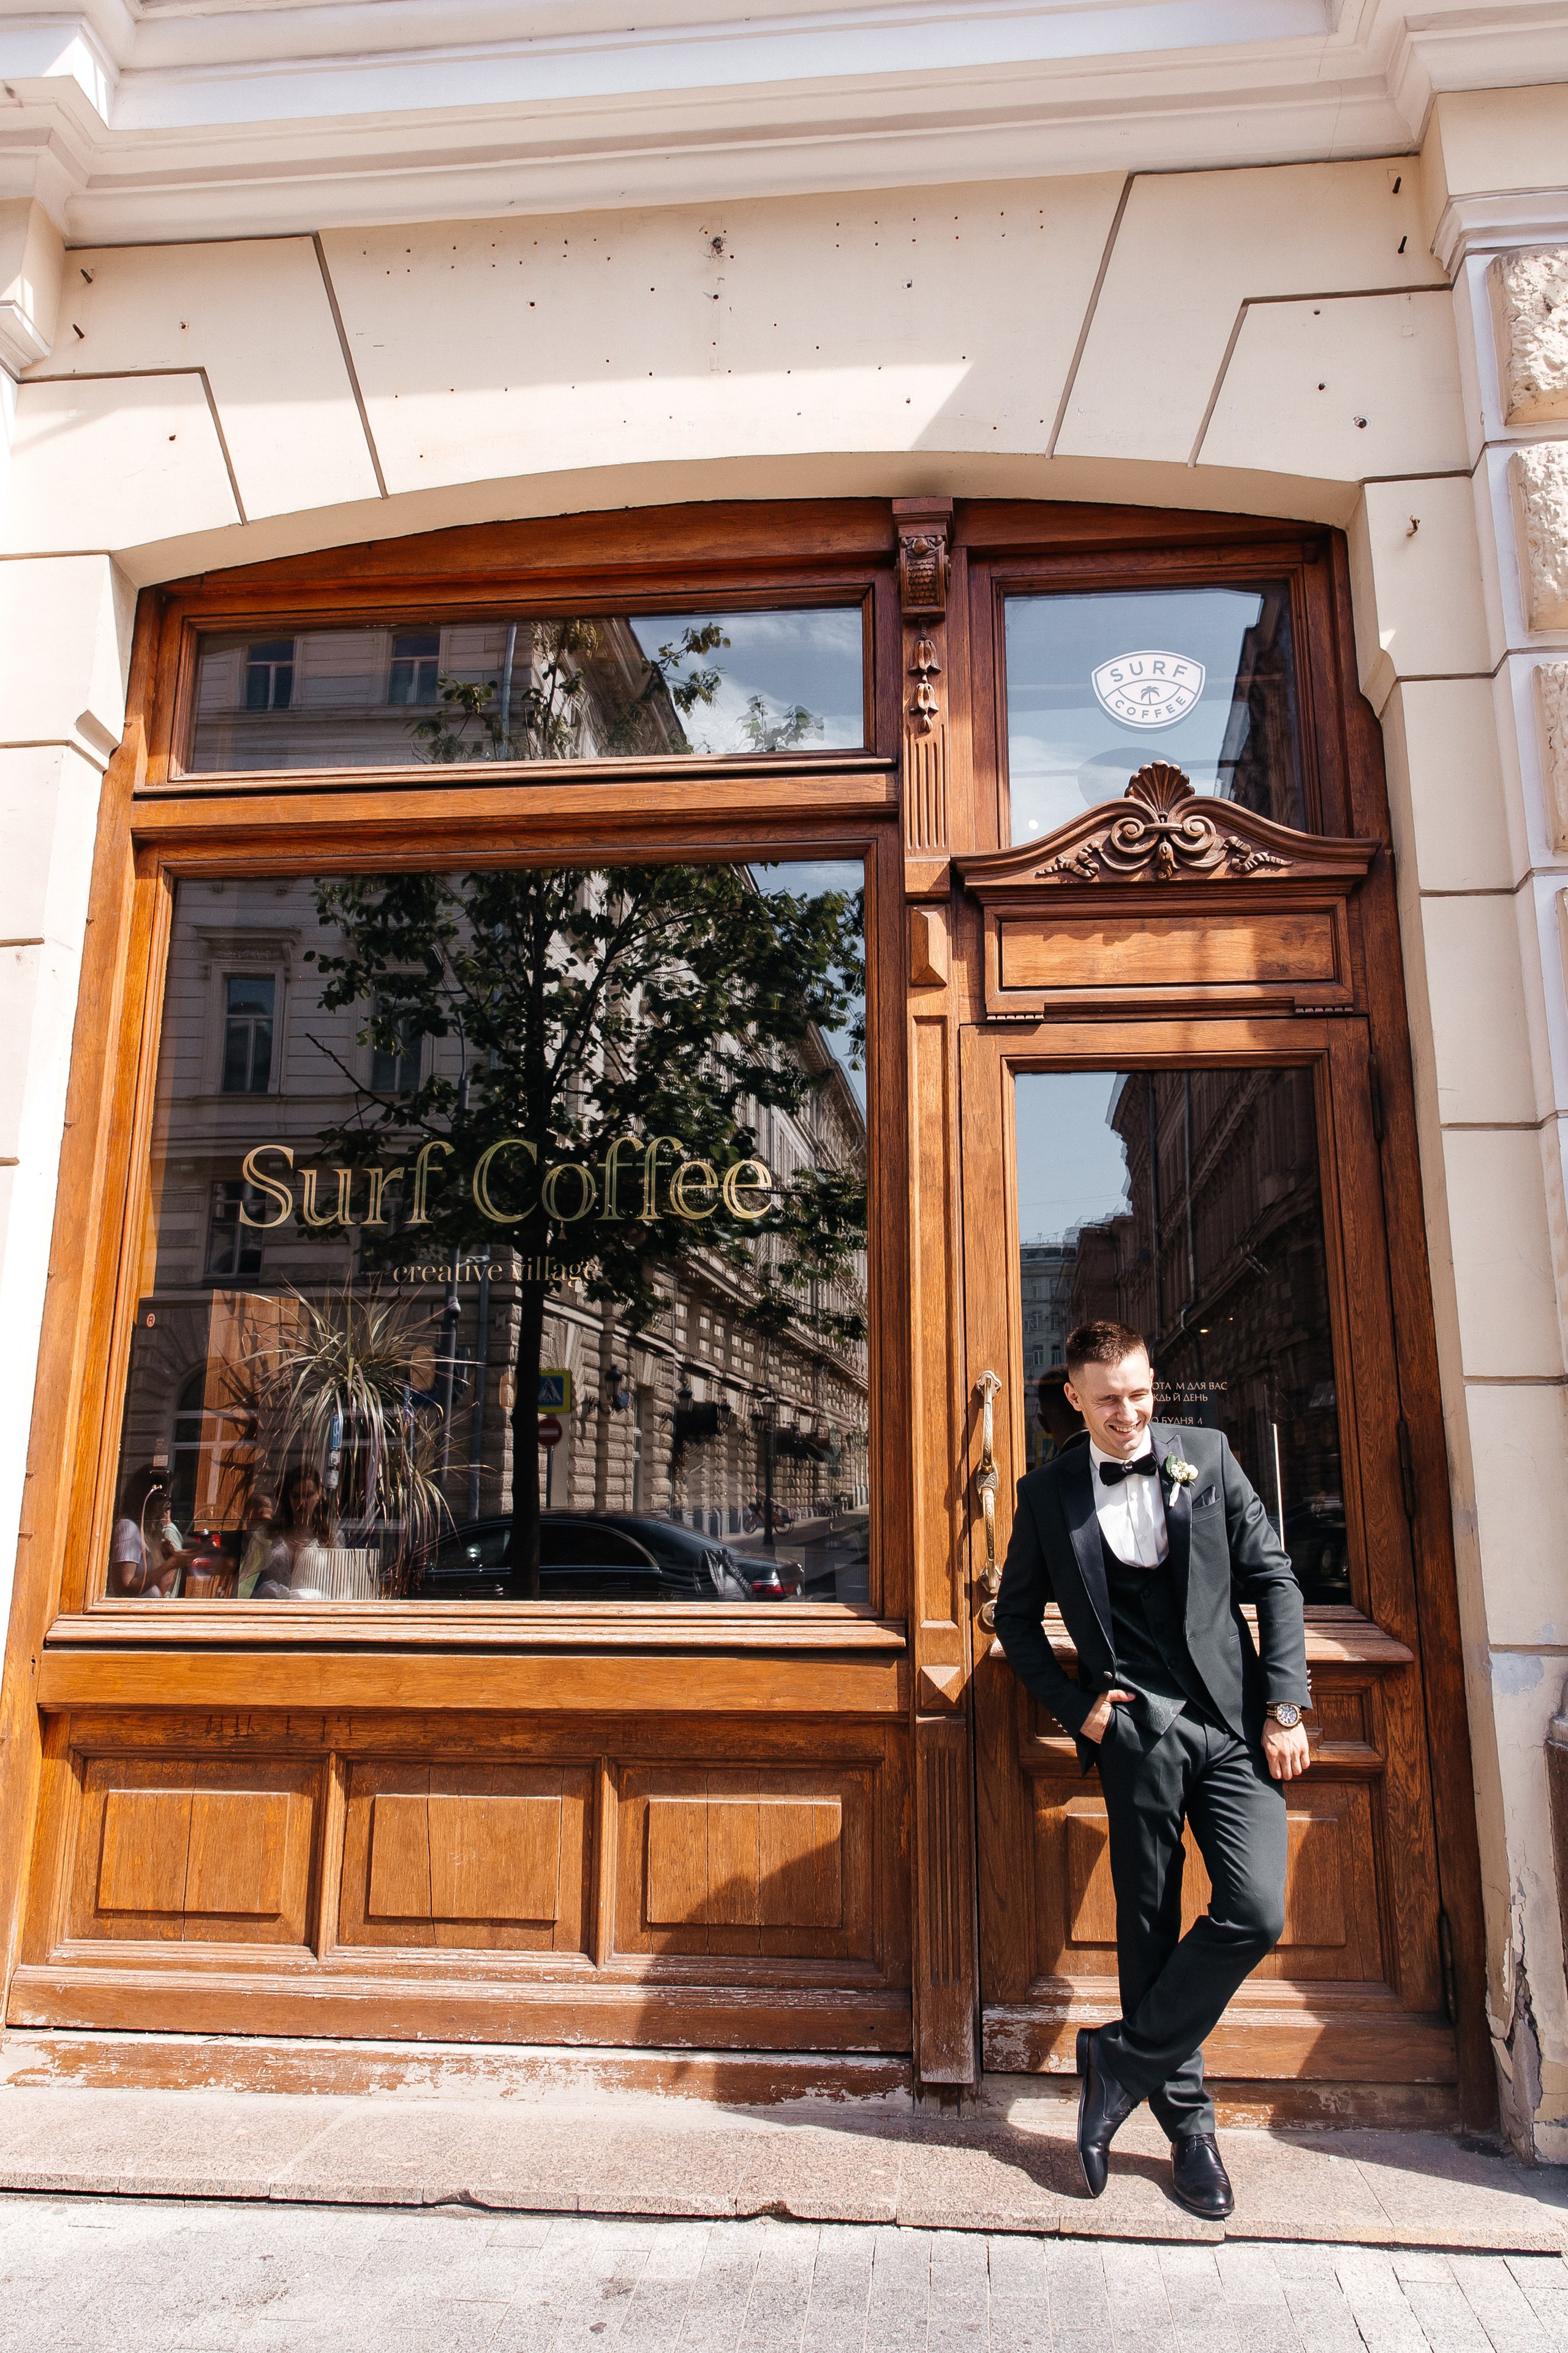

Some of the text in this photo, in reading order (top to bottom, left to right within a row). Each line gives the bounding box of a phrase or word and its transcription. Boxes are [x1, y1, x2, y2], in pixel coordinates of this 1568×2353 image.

[1110, 660, 1188, 682] SURF
[1115, 697, 1186, 719] COFFEE
[239, 1136, 772, 1228] Surf Coffee
[393, 1257, 600, 1288] creative village
